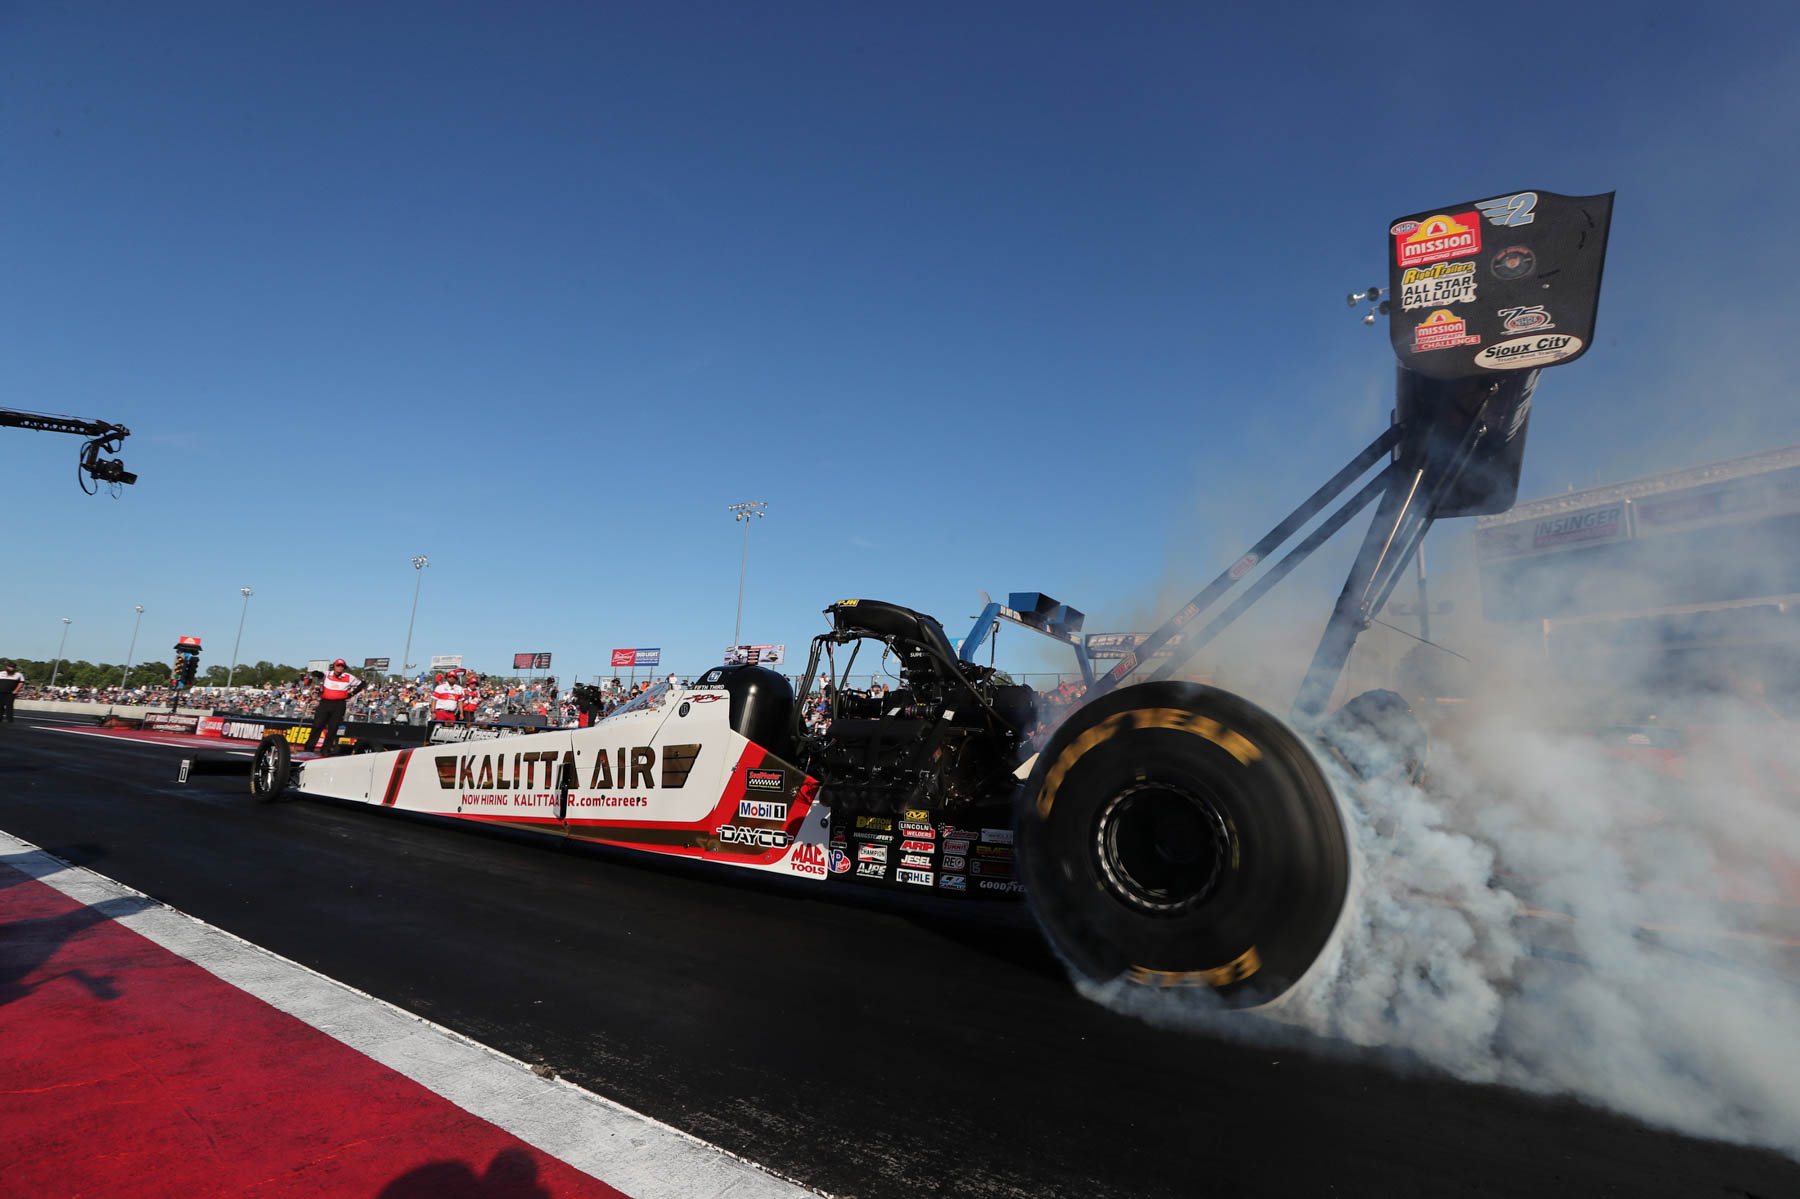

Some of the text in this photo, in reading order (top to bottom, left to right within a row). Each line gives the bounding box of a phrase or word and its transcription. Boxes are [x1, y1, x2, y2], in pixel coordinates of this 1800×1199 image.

[1505, 192, 1538, 227] 2
[1404, 276, 1472, 297] ALL STAR
[1404, 286, 1472, 306] CALLOUT
[1422, 336, 1478, 350] CHALLENGE
[1484, 336, 1572, 358] Sioux City
[1534, 508, 1620, 536] INSINGER
[286, 726, 312, 744] JEGS
[458, 746, 656, 790] KALITTA AIR
[462, 794, 480, 805] NOW
[481, 794, 508, 806] HIRING
[741, 802, 786, 819] Mobil 1
[900, 823, 930, 831] LINCOLN
[906, 830, 933, 838] WELDERS
[720, 825, 789, 849] DAYCO
[902, 840, 934, 851] ARP
[791, 843, 825, 866] MAC
[861, 849, 885, 858] CHAMPION
[901, 854, 932, 867] JESEL
[791, 863, 825, 876] TOOLS
[857, 862, 887, 877] AJPE
